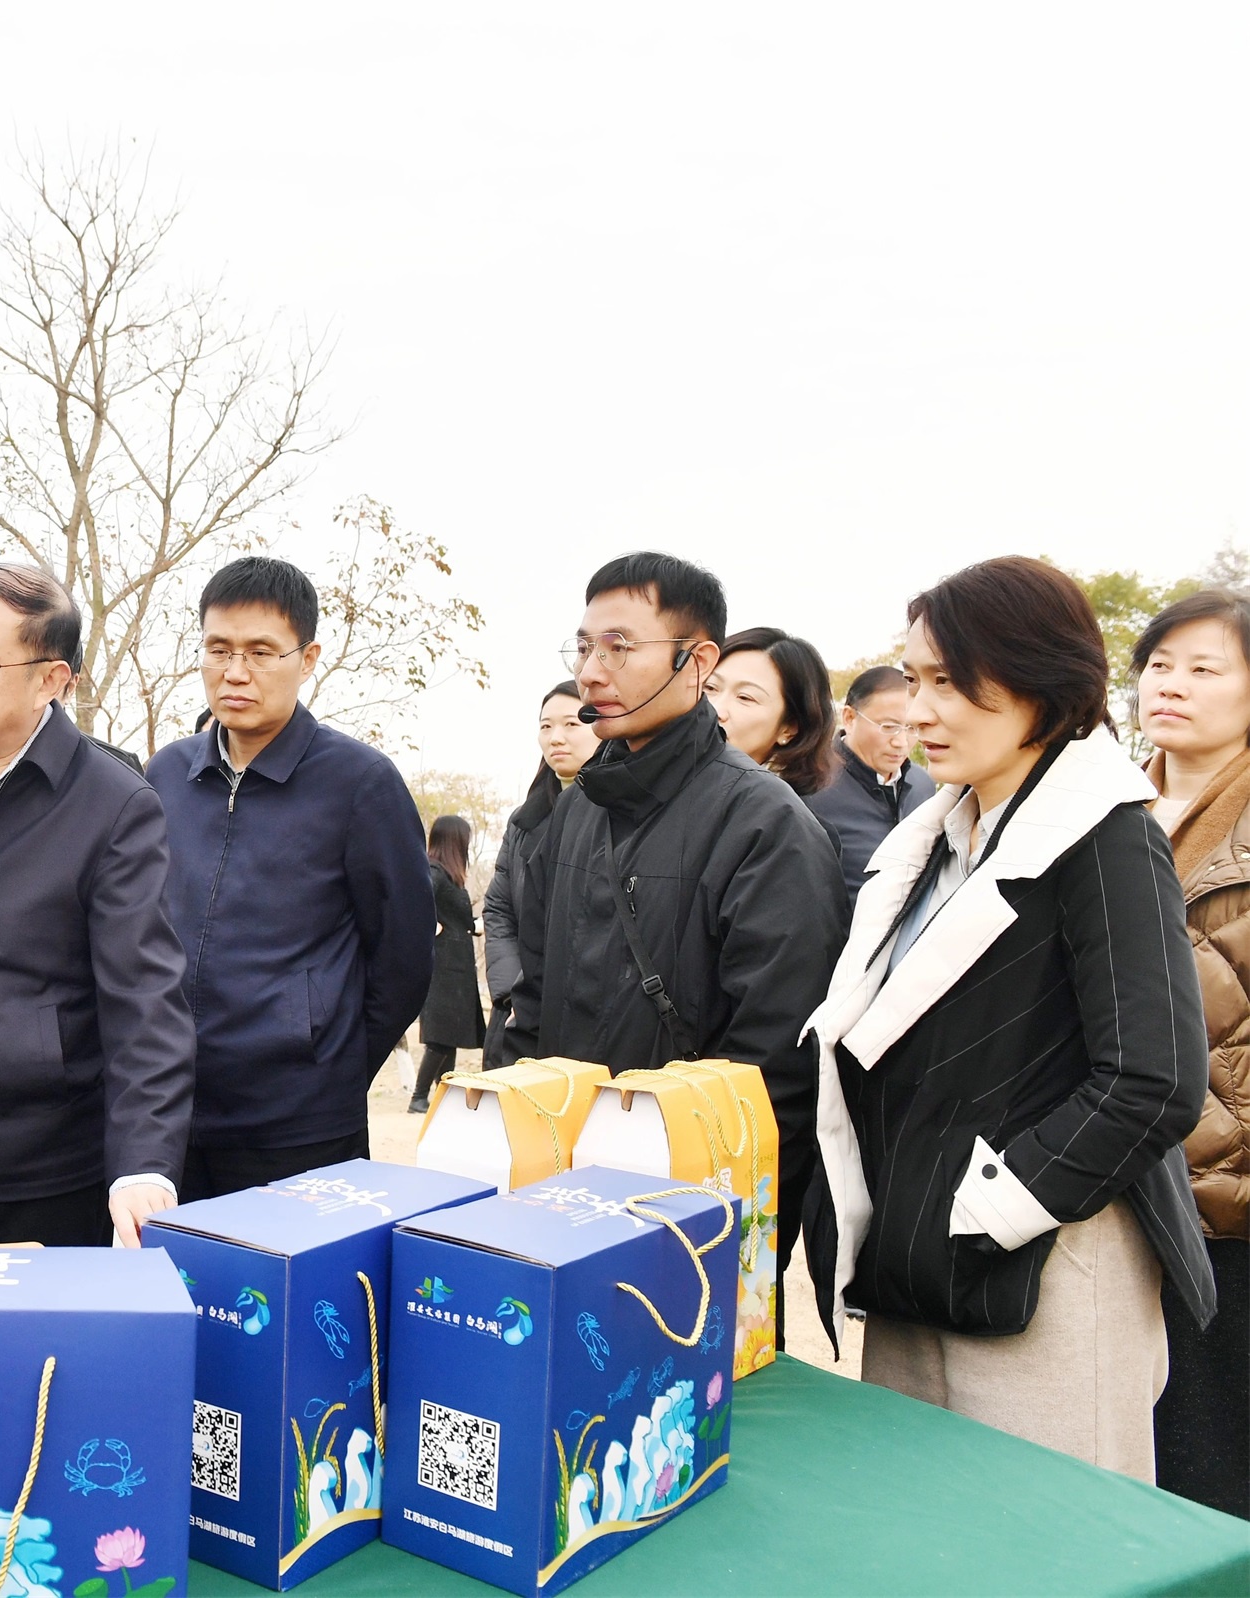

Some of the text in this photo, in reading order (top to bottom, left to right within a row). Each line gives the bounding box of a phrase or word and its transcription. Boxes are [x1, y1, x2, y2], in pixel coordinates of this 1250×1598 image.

[285, 1178, 392, 1217] 特产
[208, 1305, 239, 1325] 白马湖
[465, 1314, 499, 1335] 白马湖
[403, 1507, 514, 1558] 江苏淮安白马湖旅游度假区
